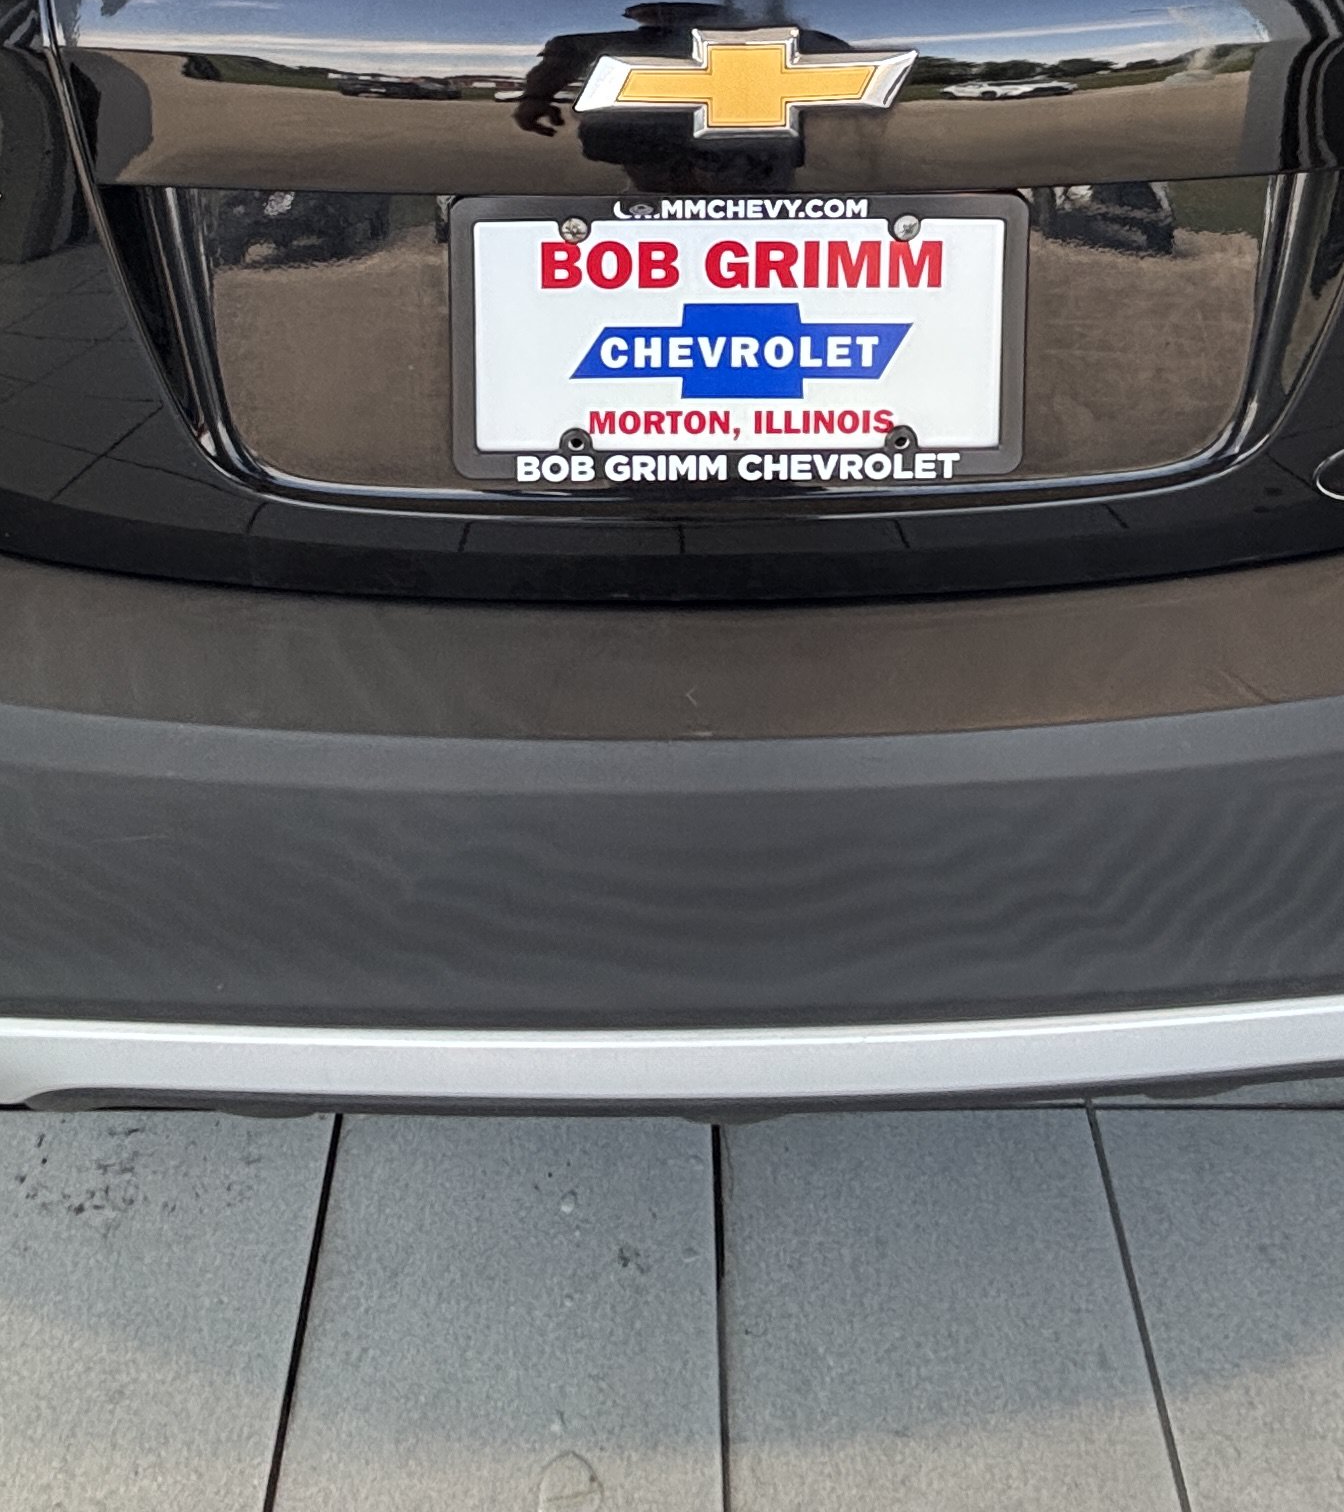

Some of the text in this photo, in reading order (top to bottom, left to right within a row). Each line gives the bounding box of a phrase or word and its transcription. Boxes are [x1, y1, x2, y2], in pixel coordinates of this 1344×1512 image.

[613, 198, 869, 219] MMCHEVY.COM
[541, 240, 944, 289] BOB GRIMM
[599, 335, 880, 369] CHEVROLET
[588, 407, 895, 440] MORTON, ILLINOIS
[516, 451, 961, 483] BOB GRIMM CHEVROLET
